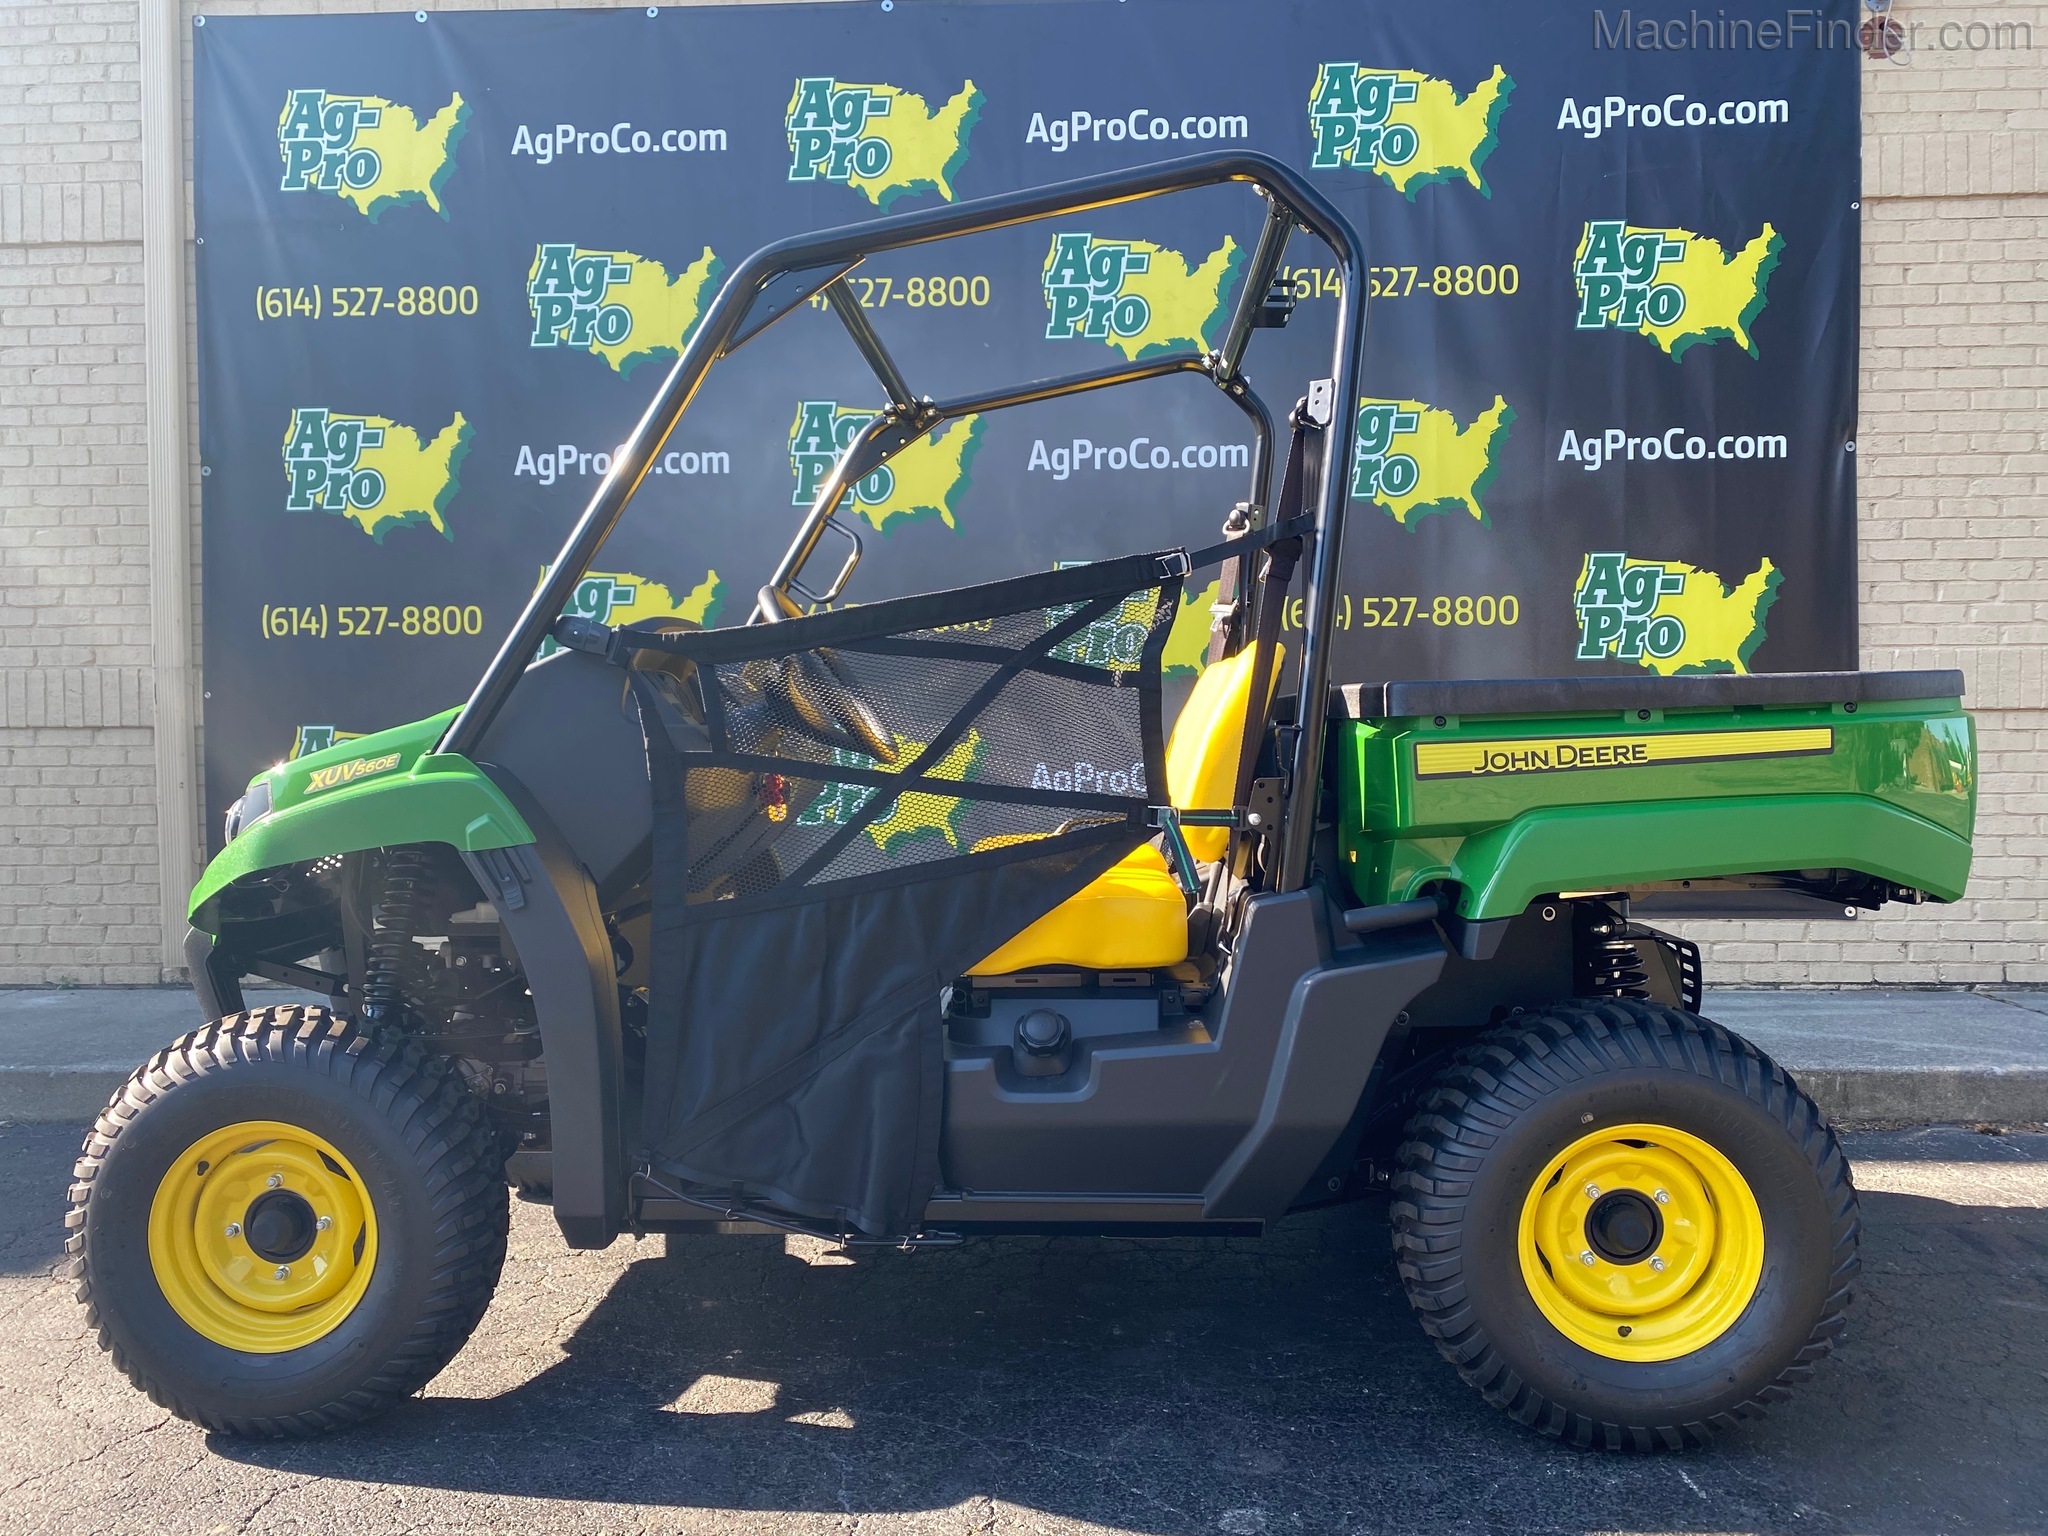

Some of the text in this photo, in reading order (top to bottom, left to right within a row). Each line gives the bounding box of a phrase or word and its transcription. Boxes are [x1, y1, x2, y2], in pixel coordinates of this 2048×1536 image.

[281, 88, 380, 150] Ag-
[788, 77, 891, 139] Ag-
[1311, 62, 1417, 125] Ag-
[1557, 94, 1789, 139] AgProCo.com
[511, 123, 728, 164] AgProCo.com
[788, 128, 891, 181] Pro
[1026, 109, 1248, 152] AgProCo.com
[1312, 115, 1417, 168] Pro
[281, 139, 380, 191] Pro
[530, 243, 631, 305] Ag-
[1045, 232, 1149, 297] Ag-
[1576, 220, 1685, 285] Ag-
[256, 284, 478, 321] (614) 527-8800
[847, 275, 991, 308] 27-8800
[1282, 265, 1342, 298] (614
[1577, 275, 1685, 328] Pro
[531, 295, 632, 346] Pro
[1045, 286, 1149, 339] Pro
[285, 408, 383, 470] Ag-
[1354, 404, 1418, 456] g-
[1558, 426, 1788, 471] AgProCo.com
[286, 459, 384, 510] Pro
[514, 443, 730, 486] AgPro.com
[1027, 437, 1249, 481] AgProCo.com
[1351, 455, 1418, 497] ro
[1576, 553, 1684, 617] Ag-
[261, 604, 483, 639] (614) 527-8800
[1362, 594, 1519, 628] 527-8800
[1577, 605, 1685, 659] Pro
[306, 754, 399, 792] XUV560E
[1474, 744, 1647, 771] JOHN DEERE
